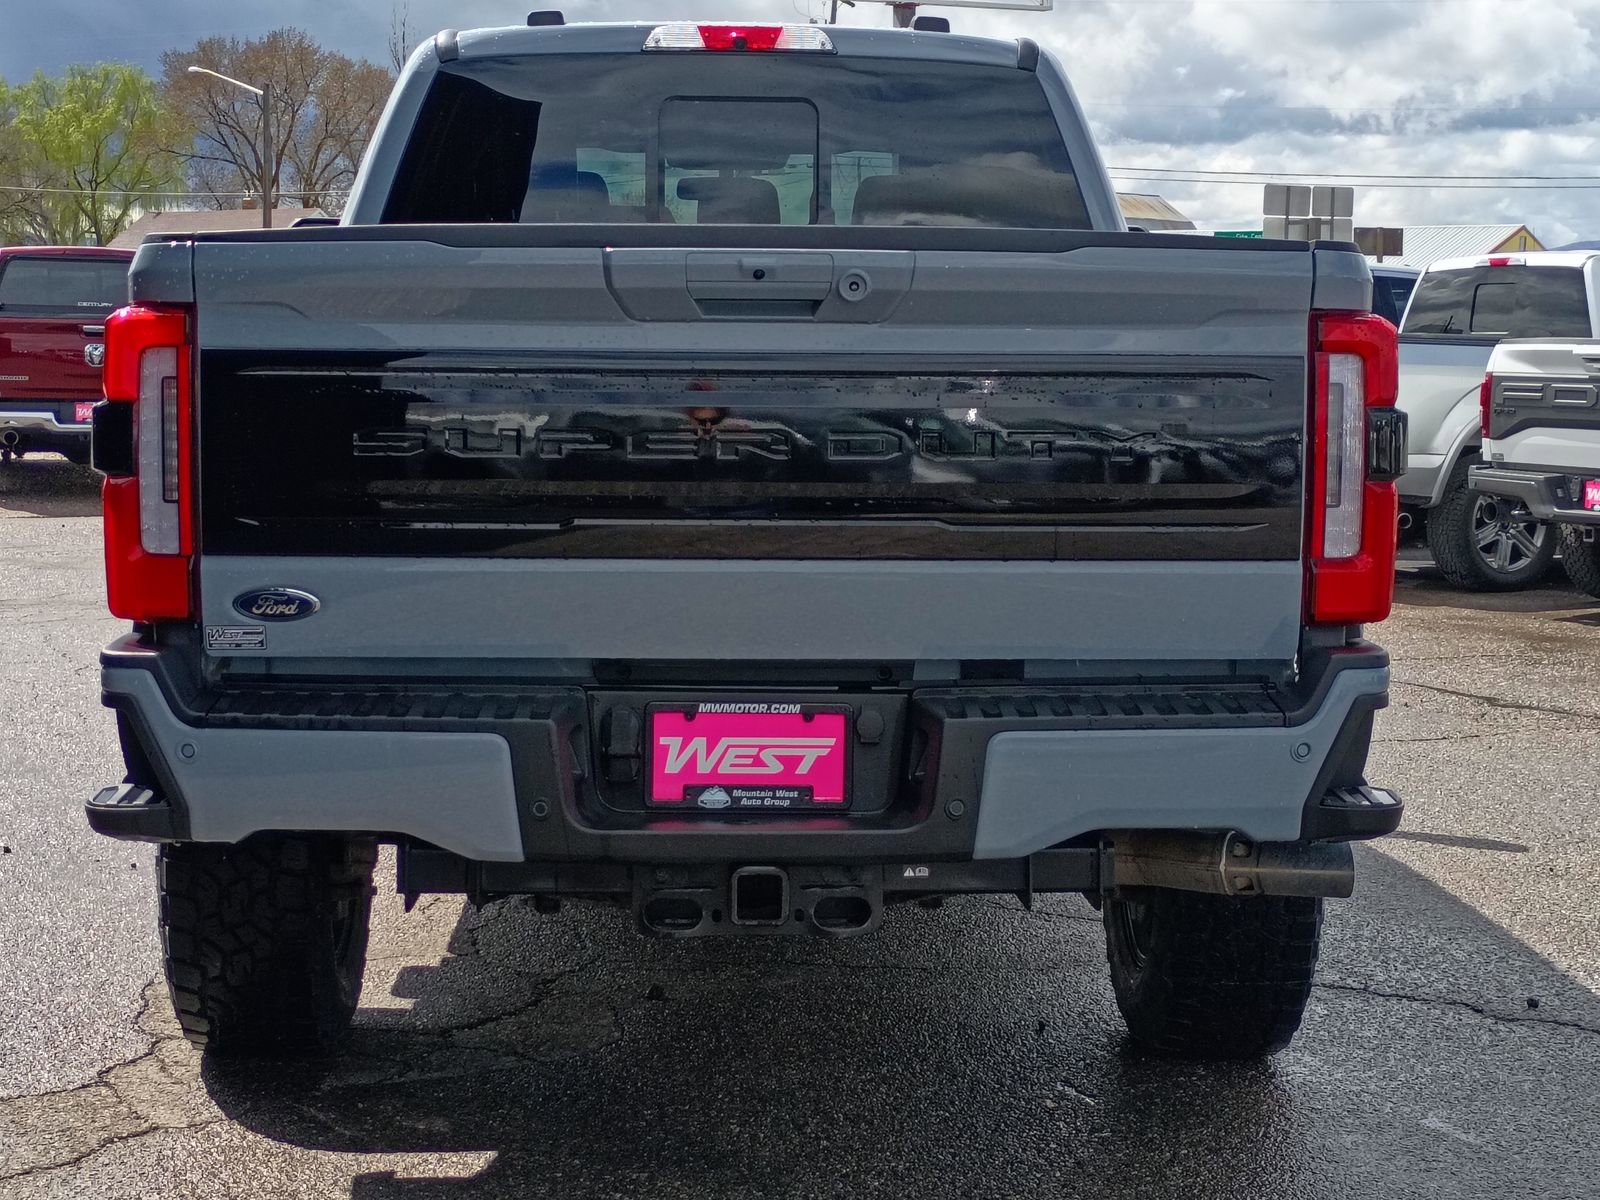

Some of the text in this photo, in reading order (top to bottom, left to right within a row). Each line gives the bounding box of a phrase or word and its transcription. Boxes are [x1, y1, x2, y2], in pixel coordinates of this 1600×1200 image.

[1495, 382, 1600, 408] FO
[352, 426, 1157, 462] SUPER DUTY
[251, 594, 300, 615] Ford
[698, 702, 801, 714] MWMOTOR.COM
[732, 788, 799, 798] Mountain West
[740, 797, 790, 807] Auto Group
